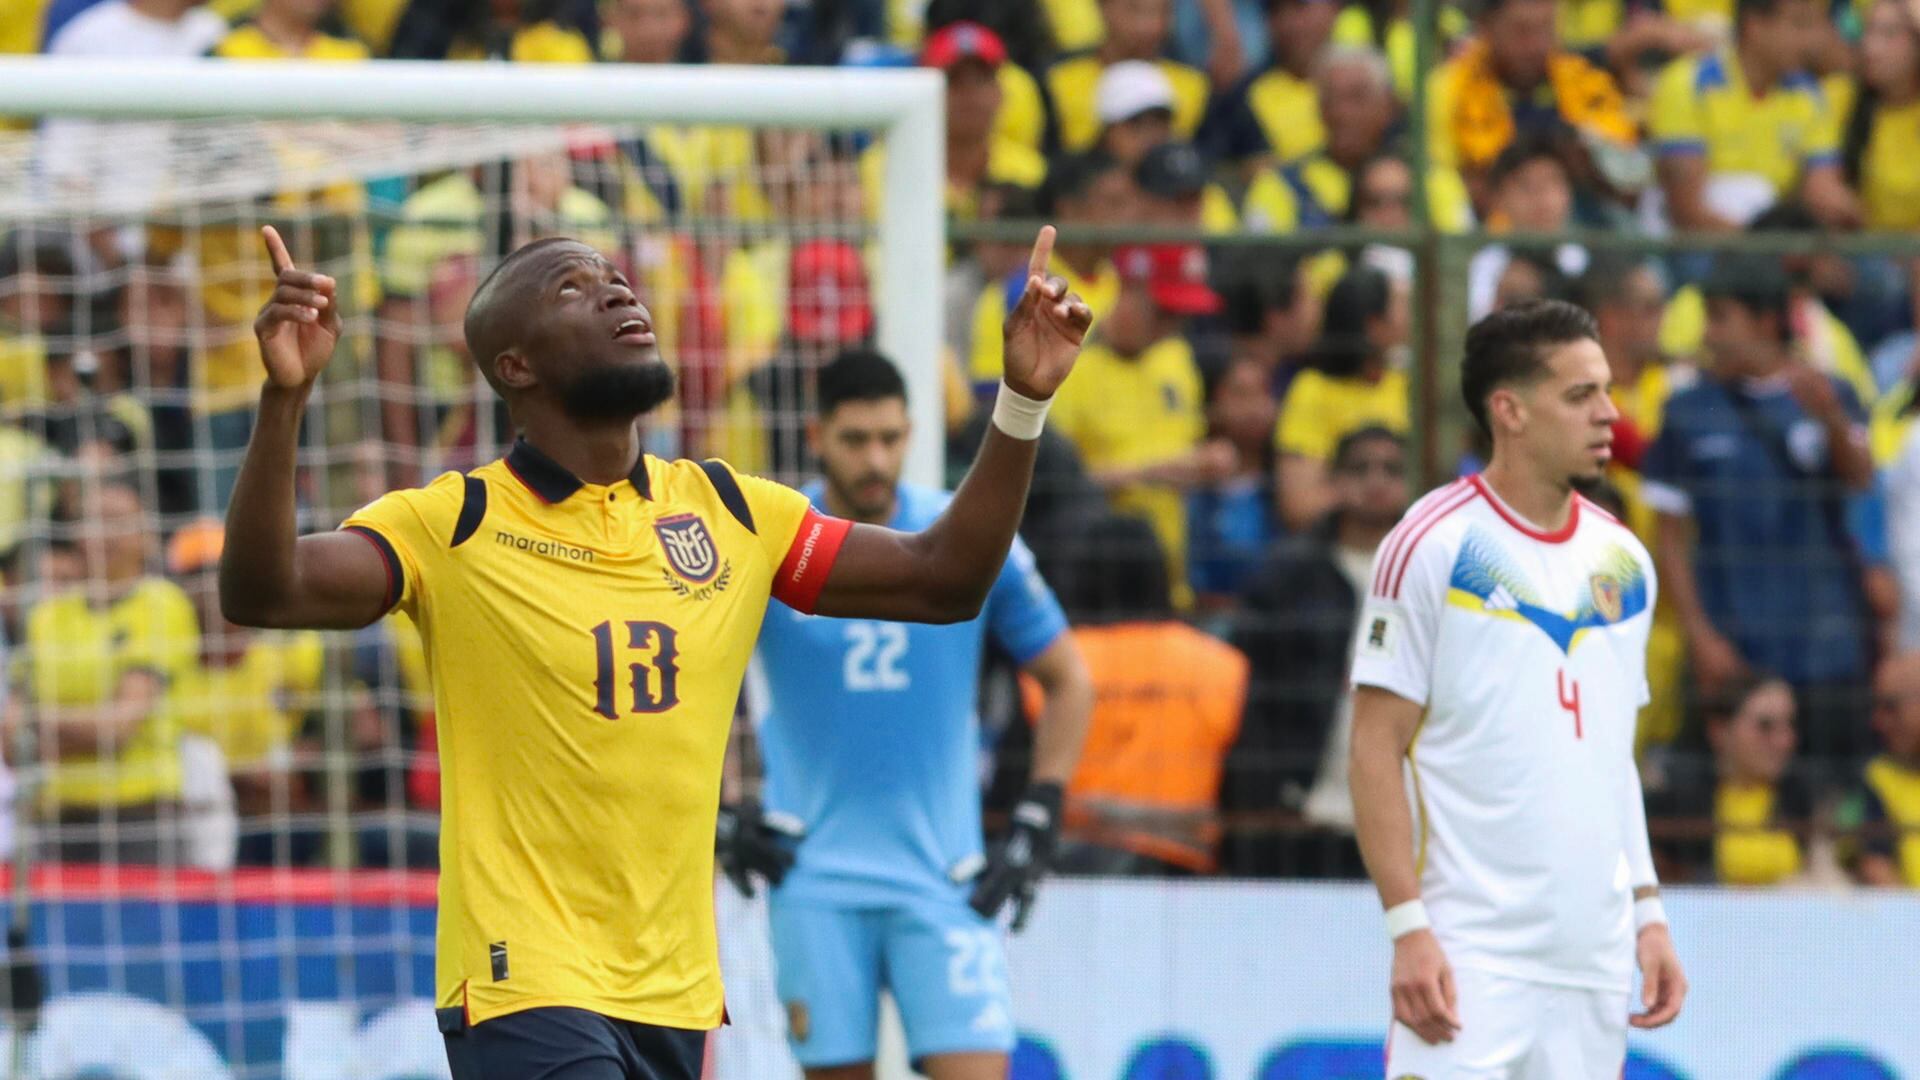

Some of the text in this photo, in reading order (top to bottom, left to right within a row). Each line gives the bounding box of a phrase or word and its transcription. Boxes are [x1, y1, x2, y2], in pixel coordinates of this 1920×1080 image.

[496, 531, 594, 562] marathon
[792, 522, 824, 582] marathon
[590, 619, 680, 720] 13
[843, 621, 911, 692] 22
[1556, 667, 1583, 740] 4
